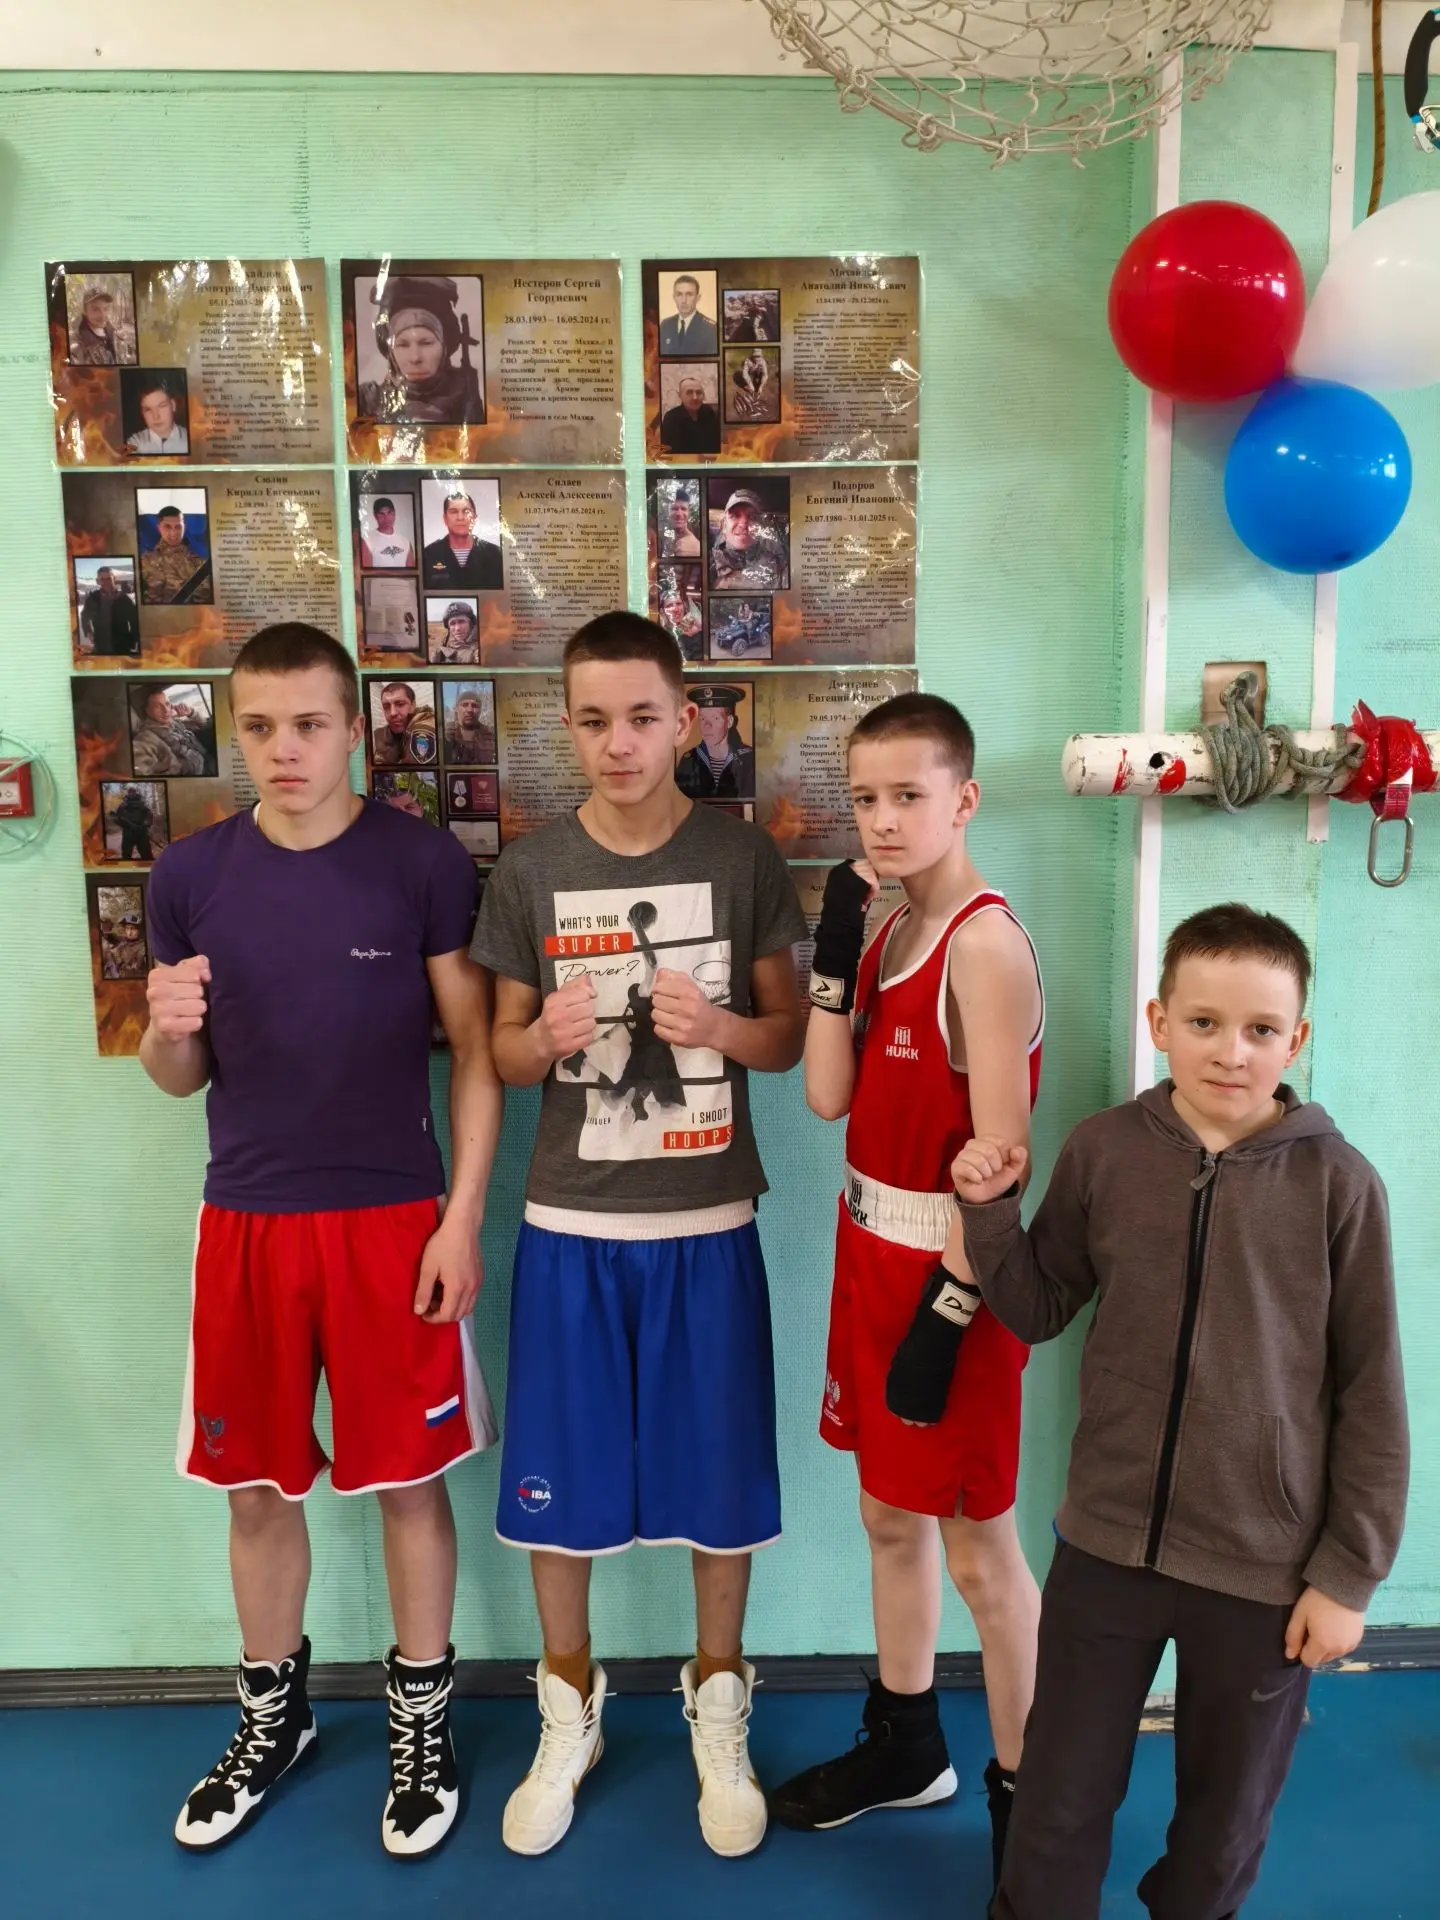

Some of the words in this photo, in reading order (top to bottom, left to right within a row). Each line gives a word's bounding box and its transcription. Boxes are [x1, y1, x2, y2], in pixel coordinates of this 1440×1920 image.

[513, 278, 562, 290] Нестеров
[564, 278, 601, 290] Сергей
[528, 292, 588, 304] Георгиевич
[546, 478, 582, 487] Силаев
[832, 481, 875, 492] Подоров
[518, 491, 556, 500] Алексей
[558, 491, 612, 500] Алексеевич
[806, 495, 848, 504] Евгений
[808, 694, 850, 702] Евгений
[558, 916, 592, 930] WHAT'S
[596, 914, 620, 928] YOUR
[558, 934, 621, 954] SUPER
[886, 1044, 919, 1060] HUKK
[692, 1112, 695, 1124] I
[700, 1108, 728, 1124] SHOOT
[669, 1127, 732, 1148] HOOPS
[531, 1490, 552, 1500] IBA
[405, 1682, 434, 1692] MAD
